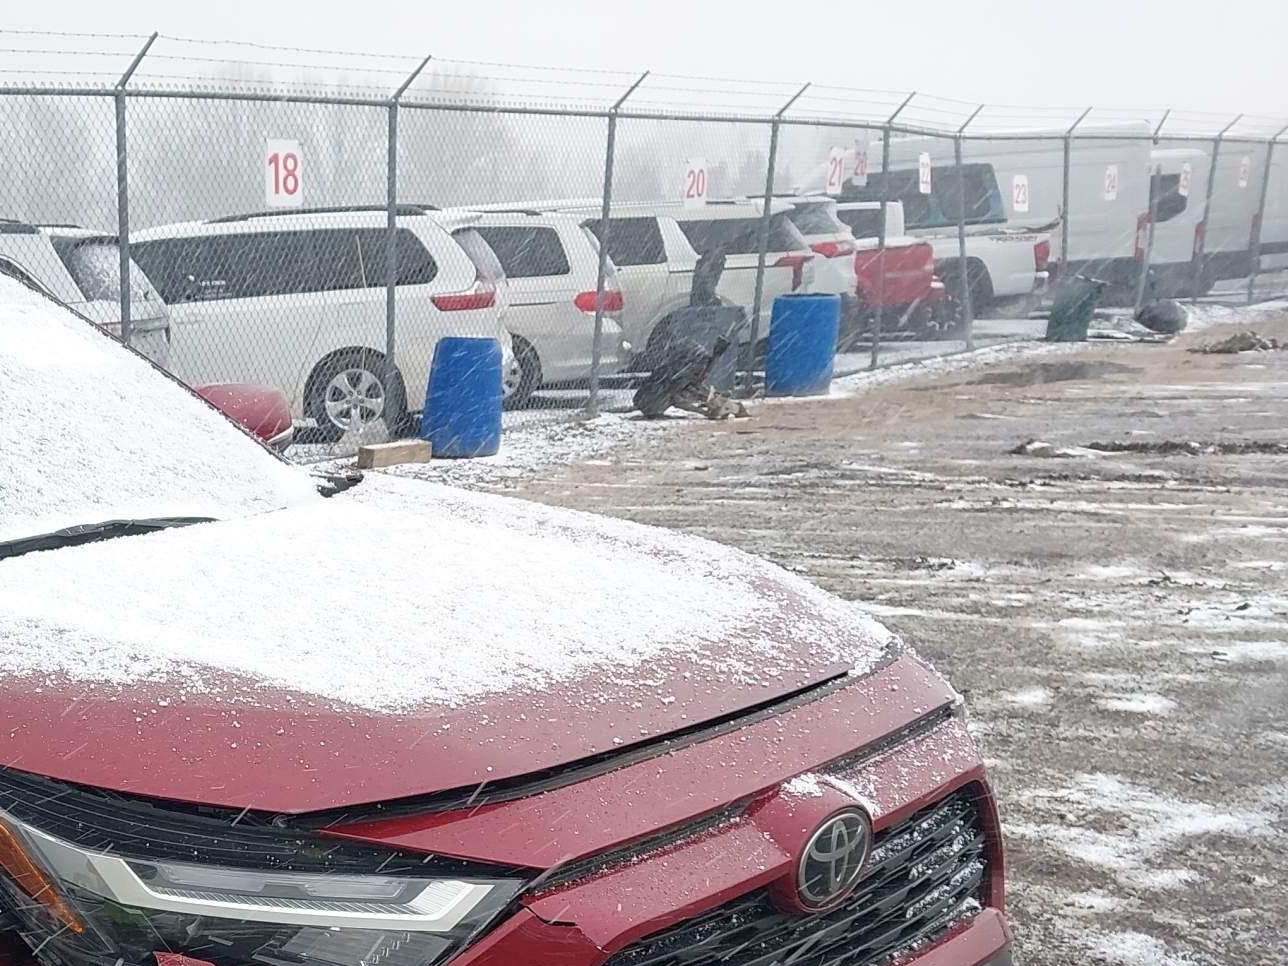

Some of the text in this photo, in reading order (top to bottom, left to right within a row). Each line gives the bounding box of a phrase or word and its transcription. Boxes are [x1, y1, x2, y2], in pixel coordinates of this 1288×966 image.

[268, 152, 299, 196] 18
[686, 168, 705, 199] 20
[828, 156, 843, 187] 21
[1015, 183, 1027, 205] 23
